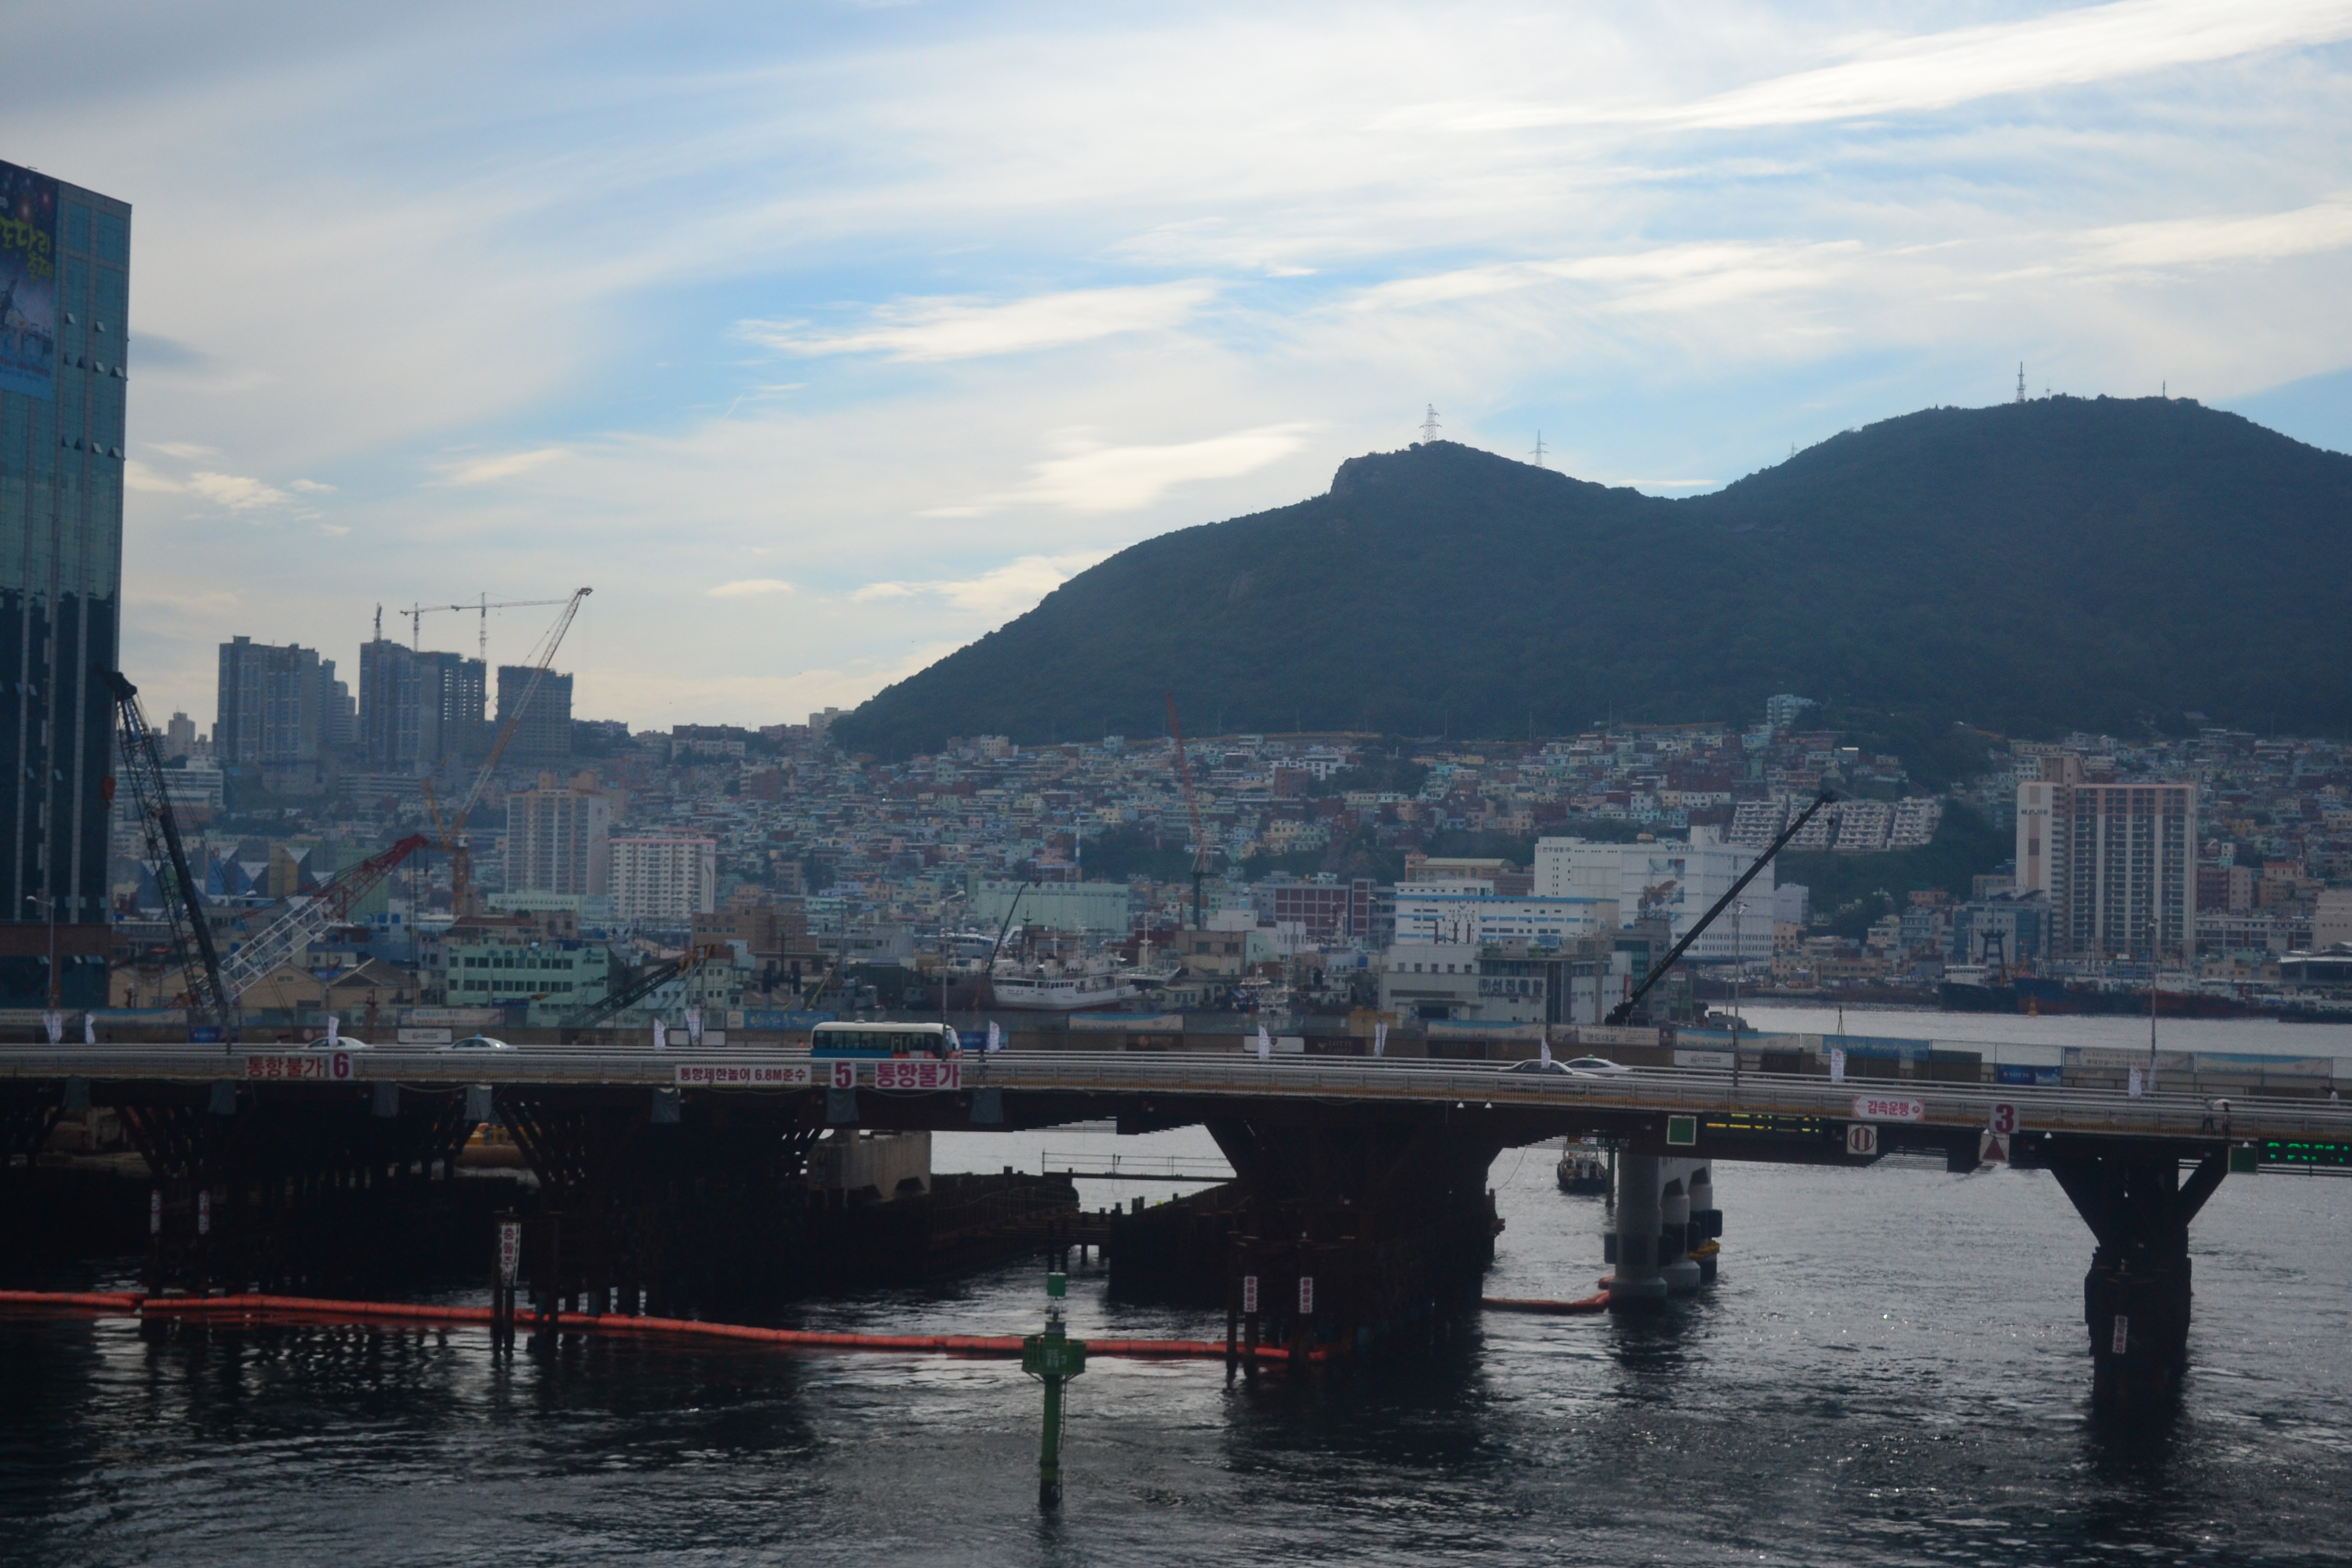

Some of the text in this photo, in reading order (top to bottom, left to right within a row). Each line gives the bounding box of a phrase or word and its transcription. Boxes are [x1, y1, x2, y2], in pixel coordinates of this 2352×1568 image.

[247, 1056, 323, 1077] 통항불가
[333, 1052, 349, 1078] 6
[680, 1067, 806, 1082] 통항제한높이 6.8M준수
[835, 1062, 853, 1088] 5
[876, 1063, 960, 1088] 통항불가
[1868, 1100, 1909, 1116] 감속운행
[1995, 1103, 2015, 1133] 3
